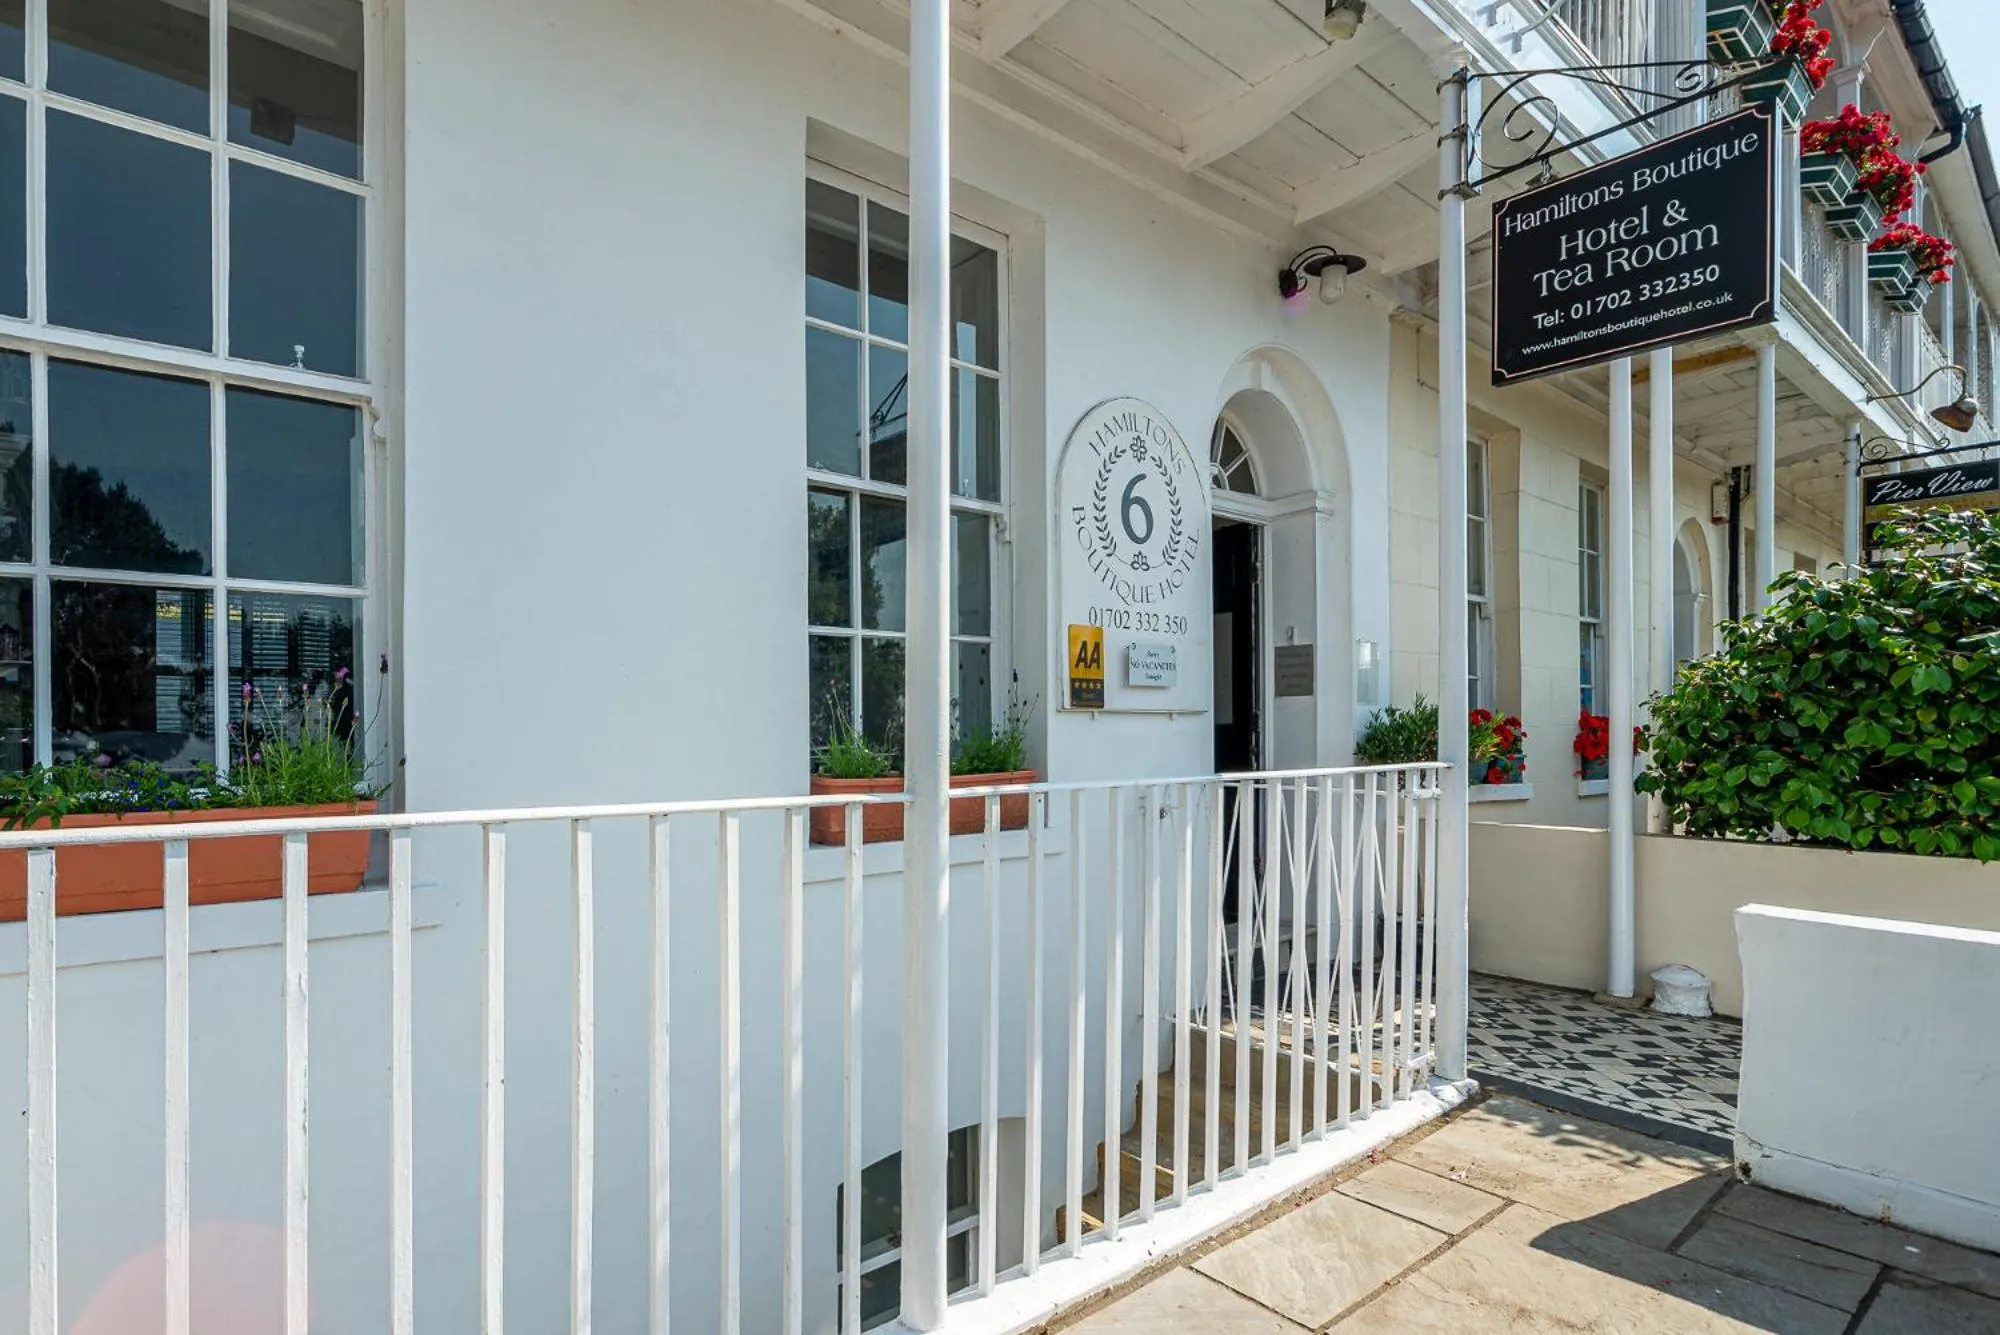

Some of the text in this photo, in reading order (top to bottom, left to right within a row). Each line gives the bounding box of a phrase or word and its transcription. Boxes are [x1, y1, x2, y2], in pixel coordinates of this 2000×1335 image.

[1504, 131, 1759, 237] Hamiltons Boutique
[1533, 223, 1720, 297] Tea Room
[1559, 199, 1689, 260] Hotel &
[1521, 291, 1733, 355] www.hamiltonsboutiquehotel.co.uk
[1533, 264, 1720, 329] Tel: 01702 332350
[1088, 412, 1187, 475] HAMILTONS
[1121, 473, 1154, 545] 6
[1871, 470, 1994, 502] Pier View
[1072, 506, 1200, 606] BOUTIQUE HOTEL
[1088, 606, 1188, 635] 01702 332 350
[1074, 640, 1101, 669] AA
